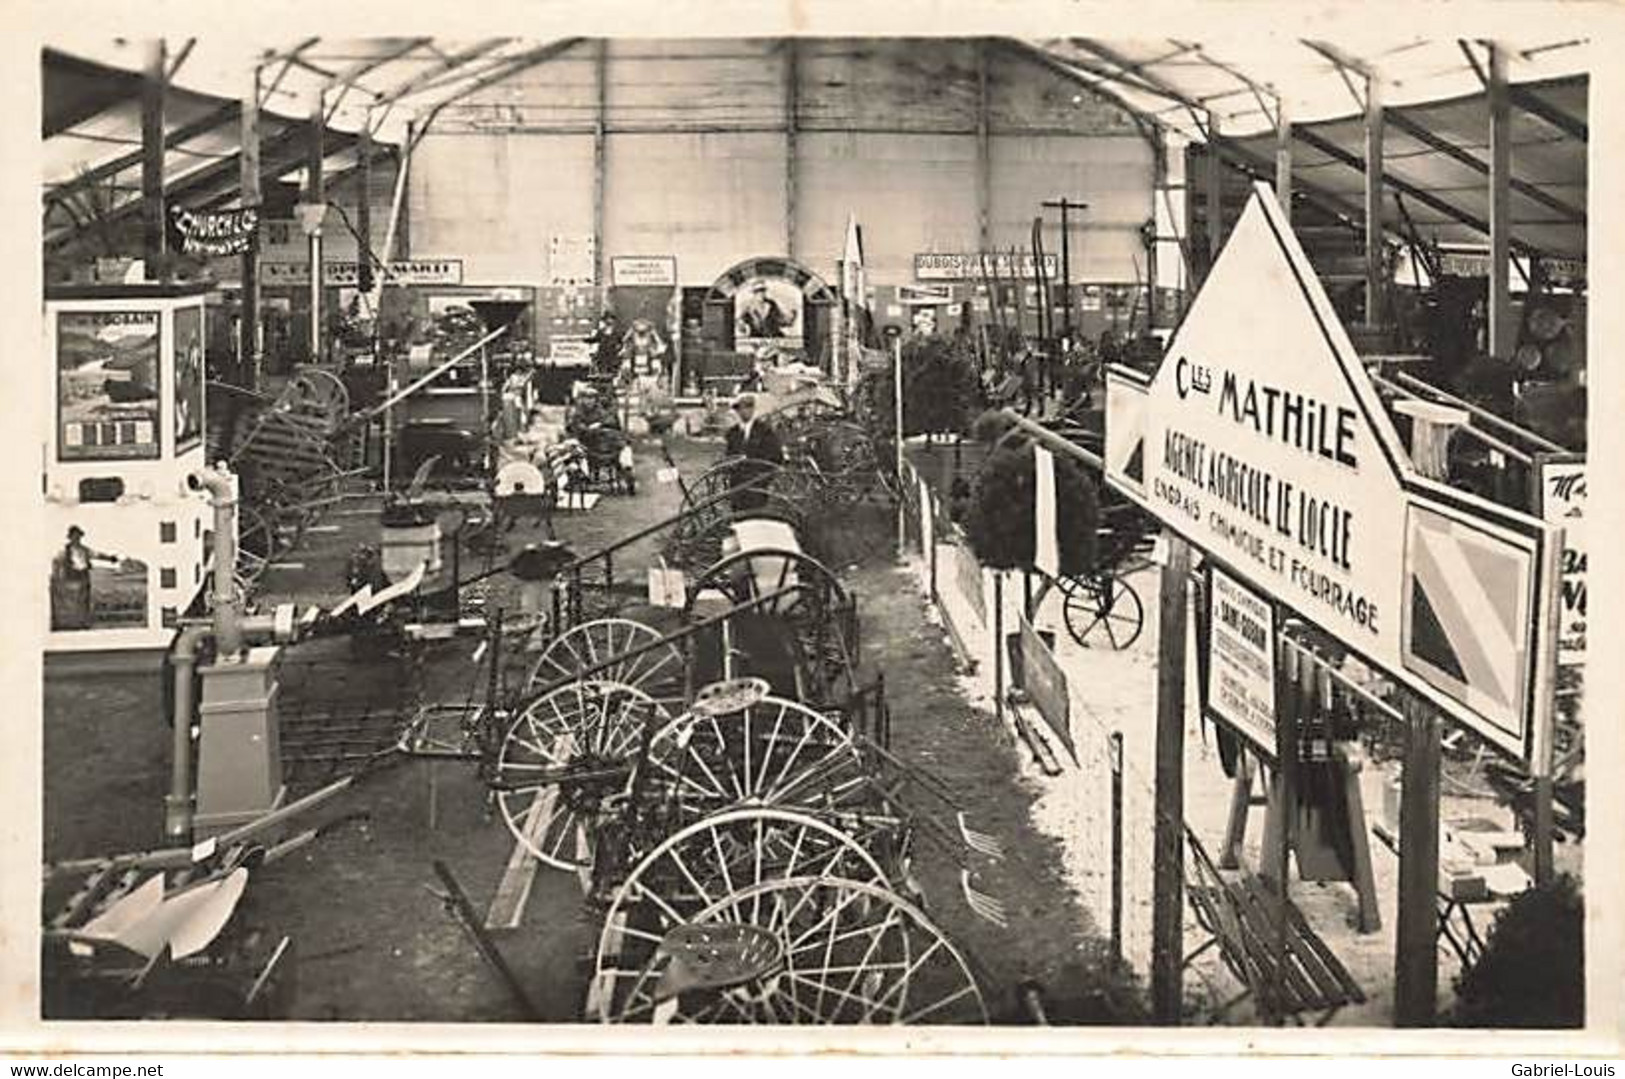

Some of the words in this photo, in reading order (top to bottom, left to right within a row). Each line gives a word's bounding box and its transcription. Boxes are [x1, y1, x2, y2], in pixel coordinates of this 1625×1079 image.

[1153, 476, 1201, 522] ENGRAIS
[1209, 510, 1266, 564] CHIMIQUE
[1269, 545, 1286, 574] ET
[1291, 558, 1380, 635] FOURRAGE
[1164, 428, 1206, 490] AGENCE
[1207, 450, 1271, 526] AGRICOLE
[1276, 479, 1293, 537] LE
[1299, 490, 1352, 570] LOCLE
